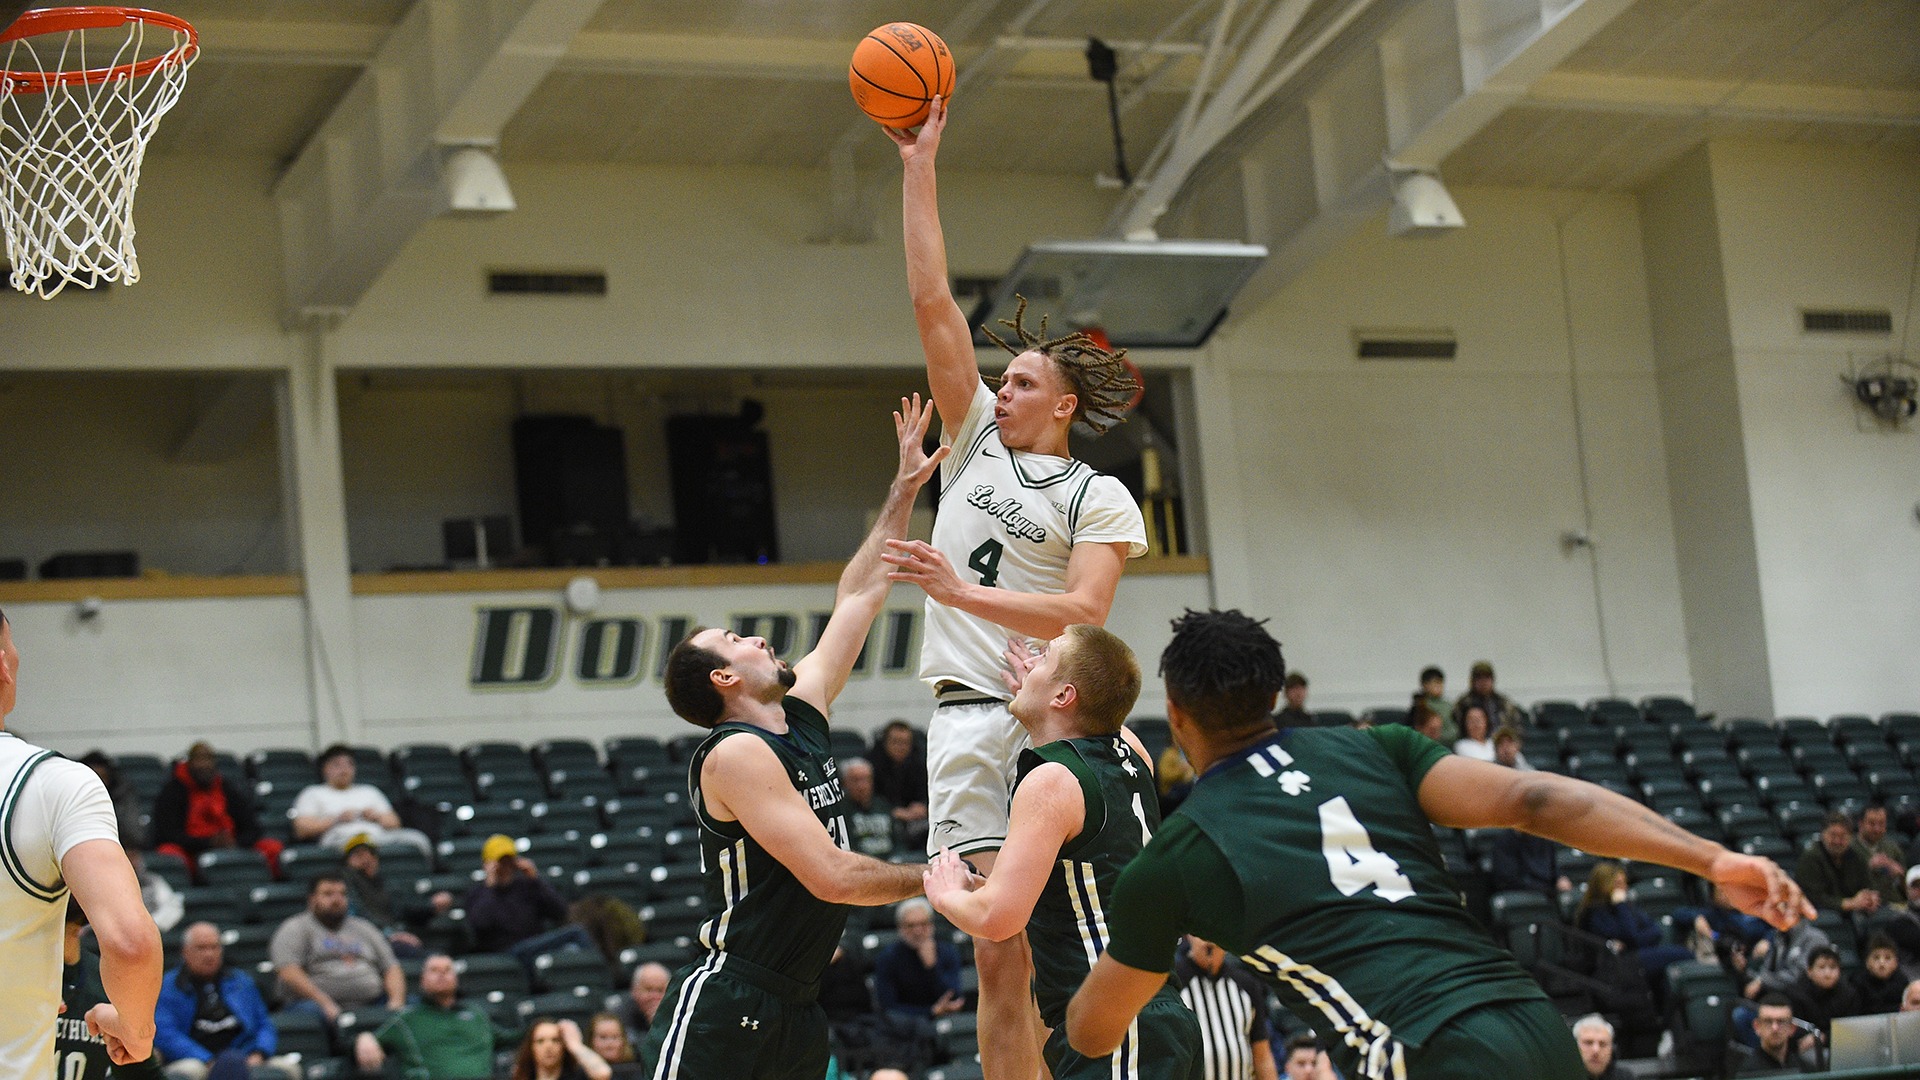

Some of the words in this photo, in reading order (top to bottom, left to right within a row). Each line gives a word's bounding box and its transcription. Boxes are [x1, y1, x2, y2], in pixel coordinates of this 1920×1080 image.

[968, 538, 1004, 587] 4
[1132, 792, 1153, 848] 1
[1318, 796, 1417, 903] 4
